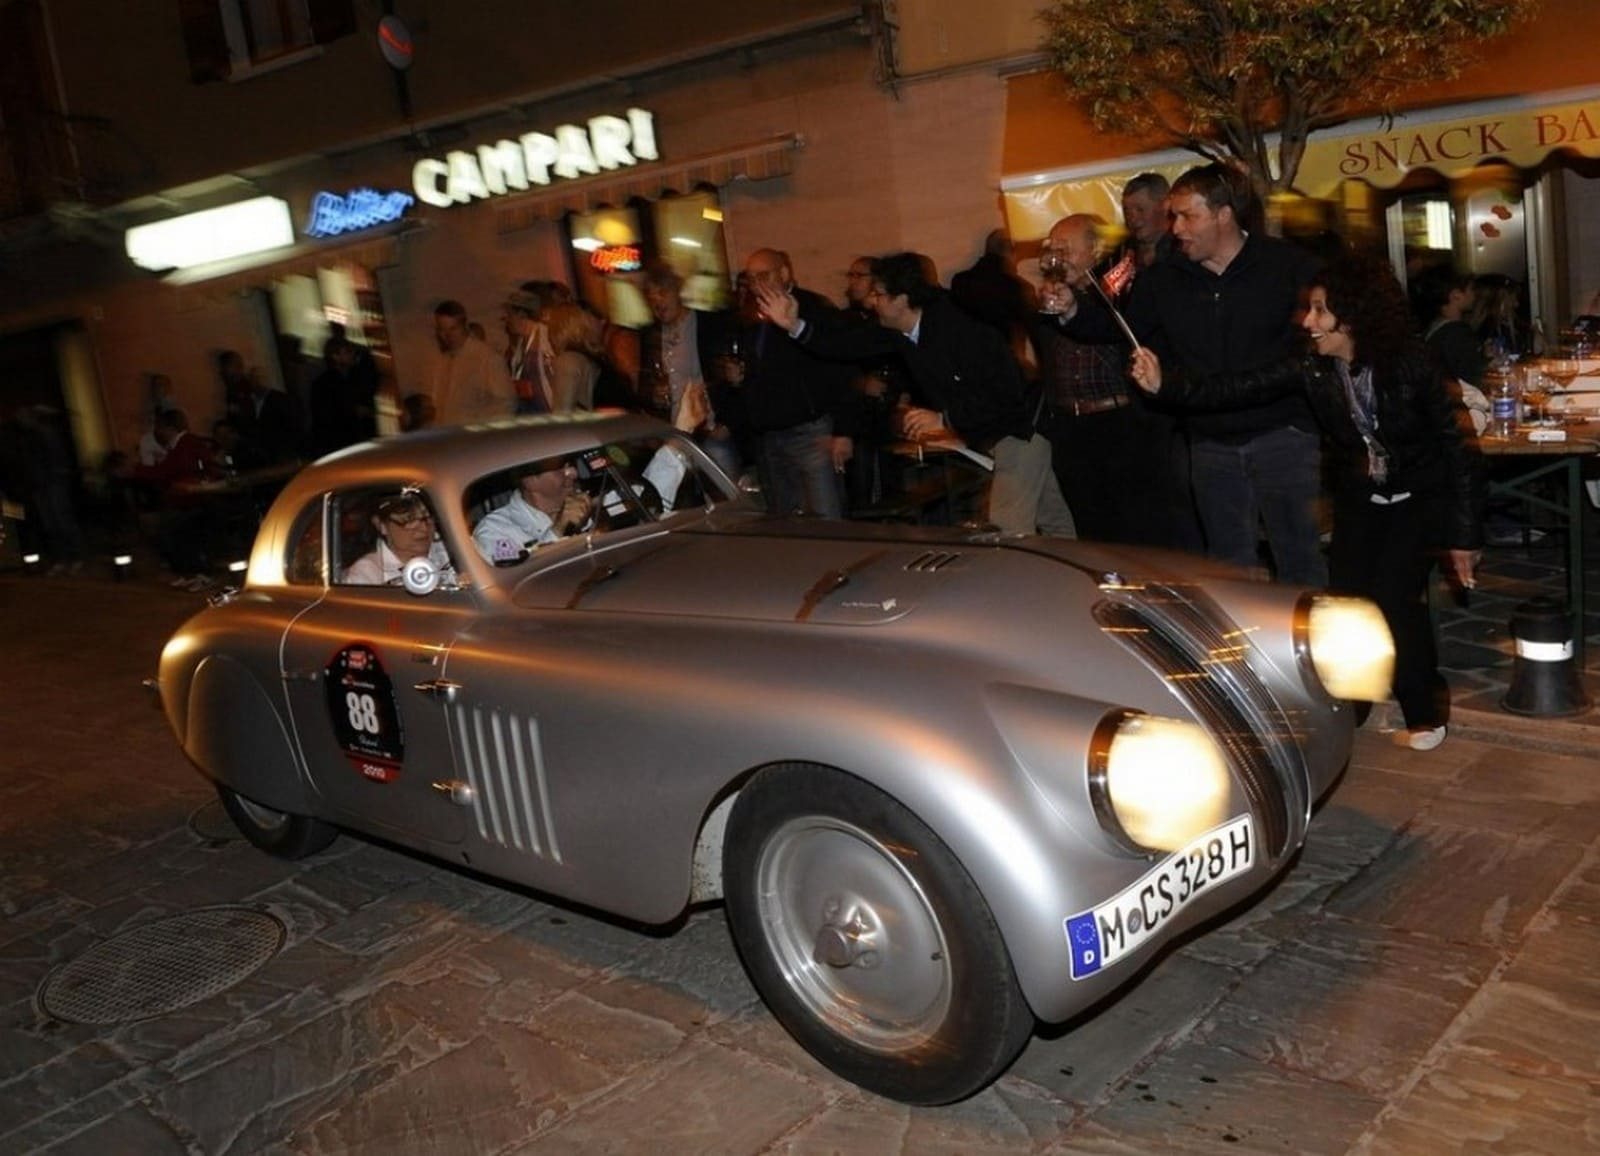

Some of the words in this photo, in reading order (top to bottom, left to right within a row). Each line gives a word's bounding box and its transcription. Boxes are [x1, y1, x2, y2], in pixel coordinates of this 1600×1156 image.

[412, 107, 659, 208] CAMPARI
[1339, 121, 1513, 176] SNACK
[1534, 108, 1600, 147] BA
[346, 691, 379, 735] 88
[1083, 949, 1096, 965] D
